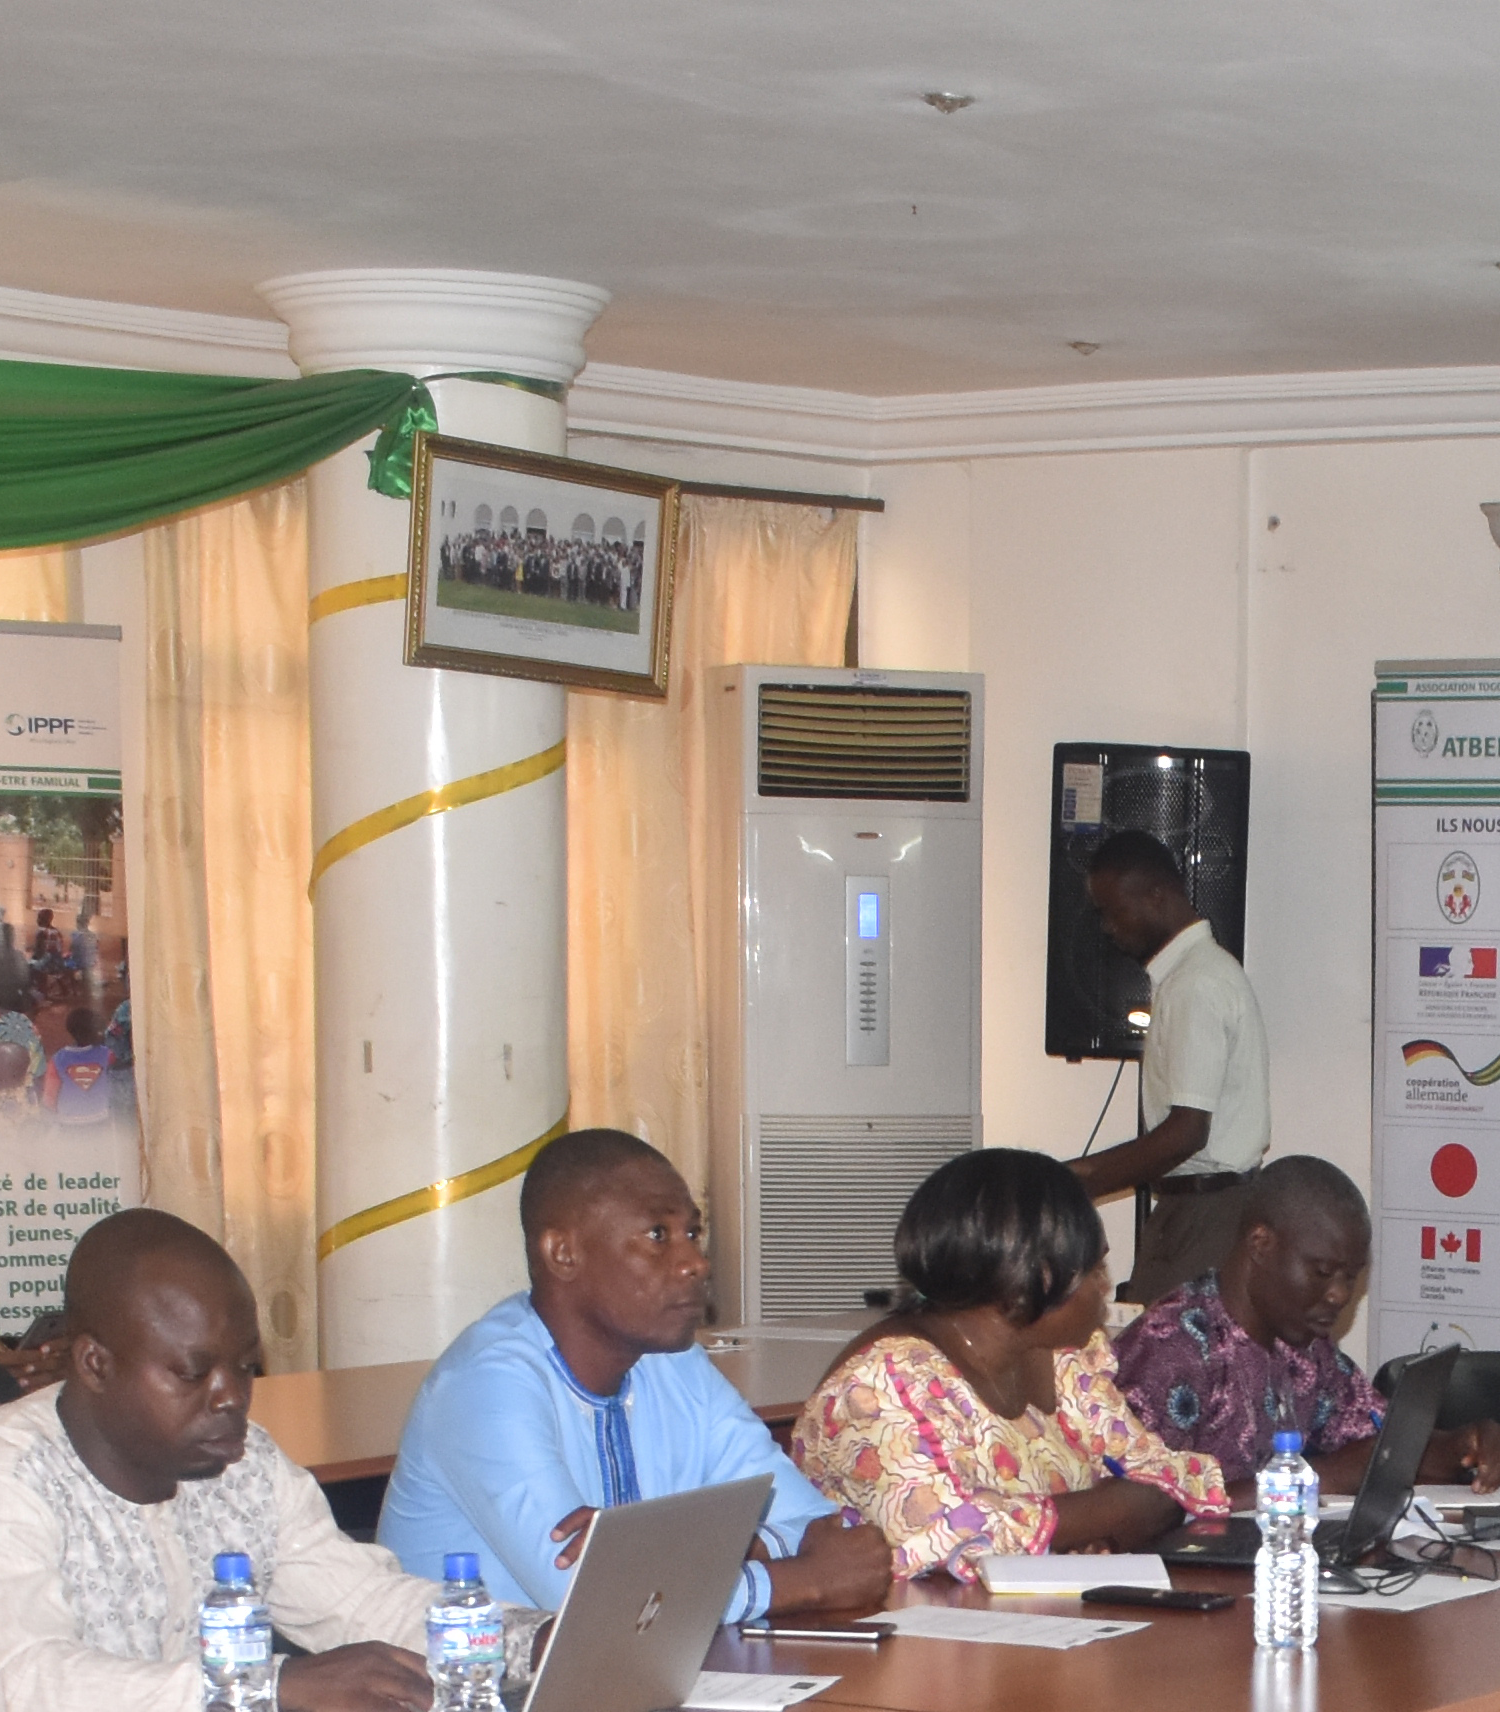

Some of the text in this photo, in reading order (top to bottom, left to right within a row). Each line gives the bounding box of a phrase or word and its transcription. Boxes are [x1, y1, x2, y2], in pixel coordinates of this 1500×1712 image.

[1415, 682, 1475, 693] ASSOCIATION
[27, 717, 75, 735] IPPF
[30, 775, 80, 788] FAMILIAL
[1436, 818, 1458, 833] ILS
[1406, 1077, 1460, 1088] coopération
[1406, 1086, 1469, 1102] allemande
[24, 1173, 47, 1190] de
[59, 1172, 120, 1190] leader
[24, 1198, 48, 1216] de
[54, 1197, 121, 1219] qualité
[8, 1225, 80, 1246] jeunes,
